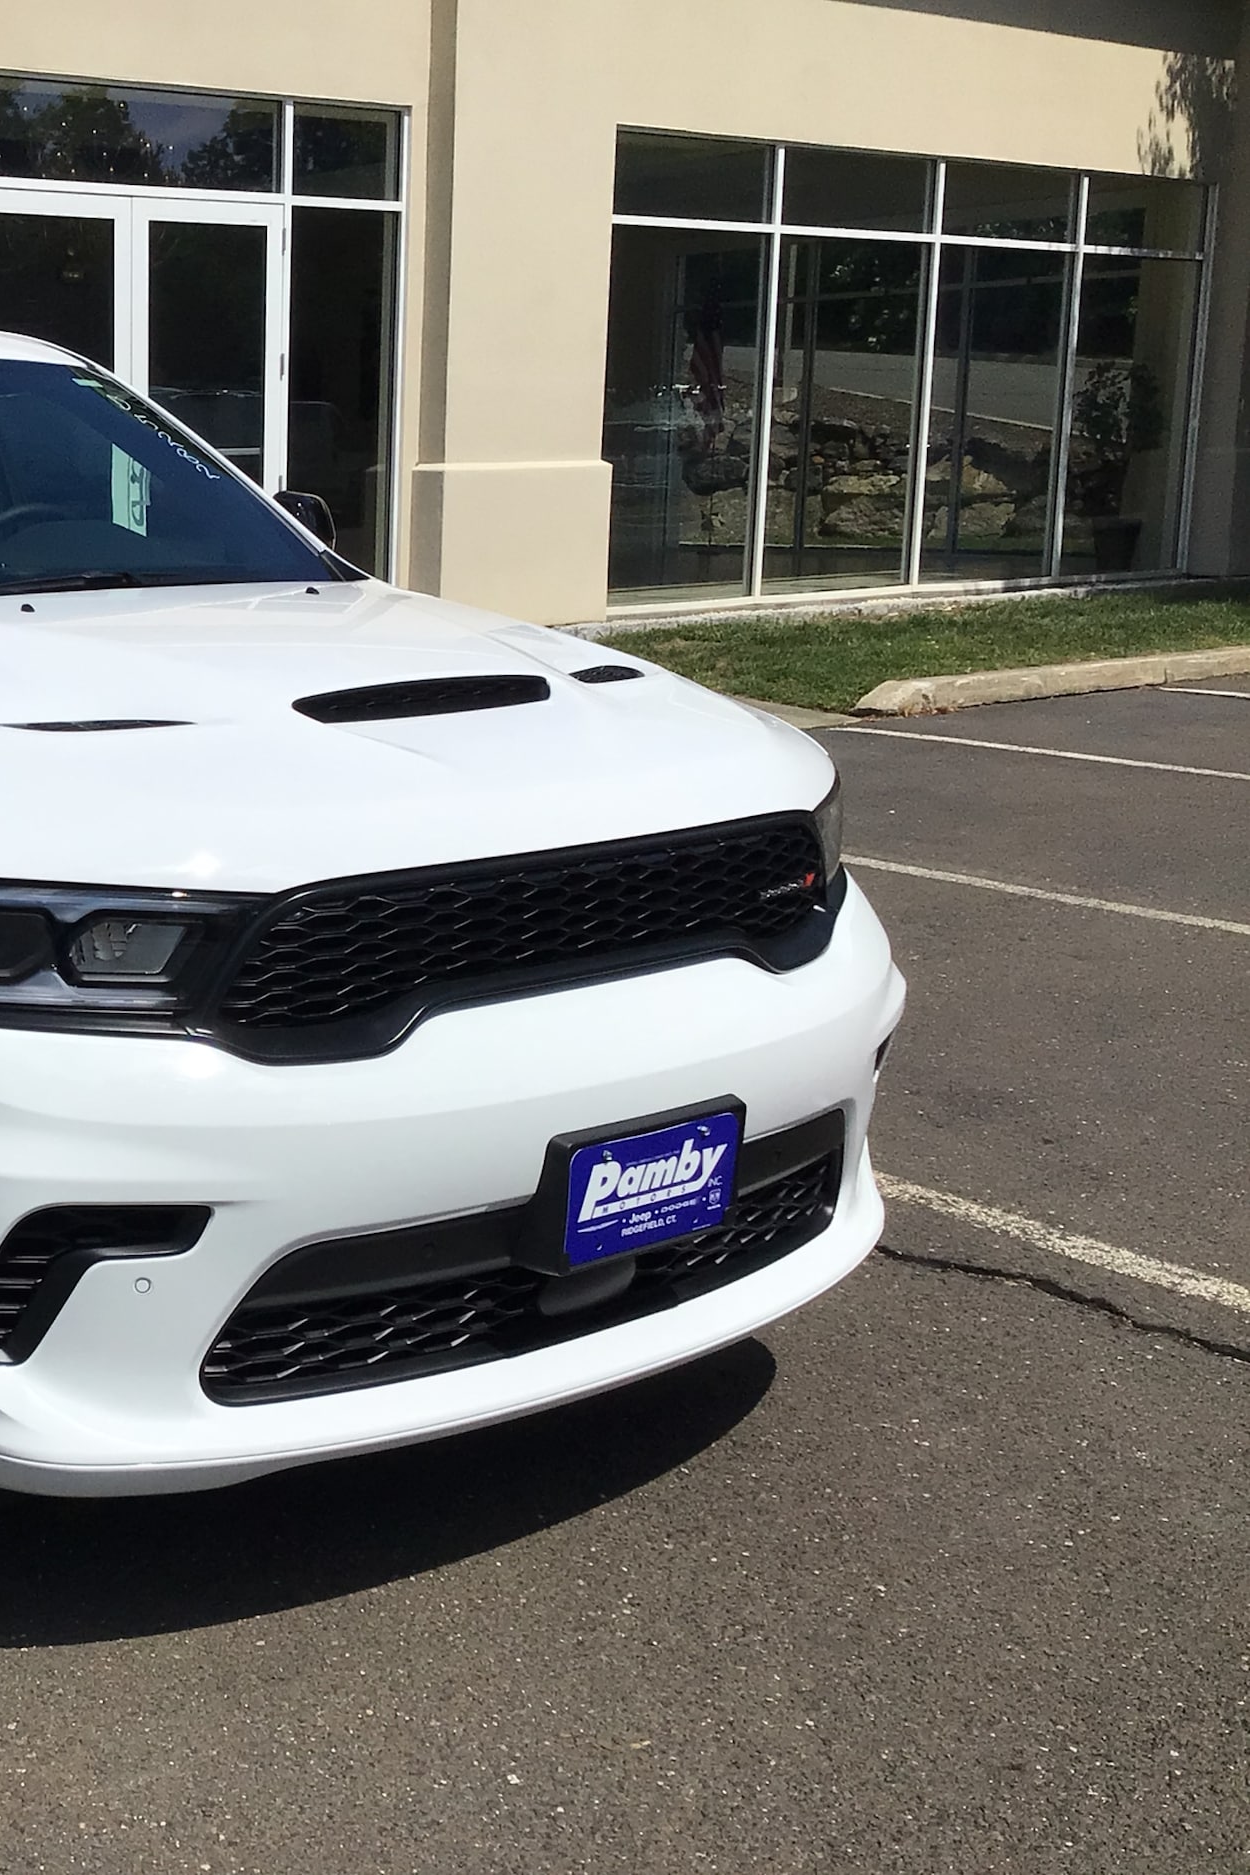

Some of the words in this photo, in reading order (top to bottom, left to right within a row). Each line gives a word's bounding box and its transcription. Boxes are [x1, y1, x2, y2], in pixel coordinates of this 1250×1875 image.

[577, 1138, 728, 1223] Pamby
[602, 1186, 687, 1214] MOTORS
[629, 1211, 652, 1224] Jeep
